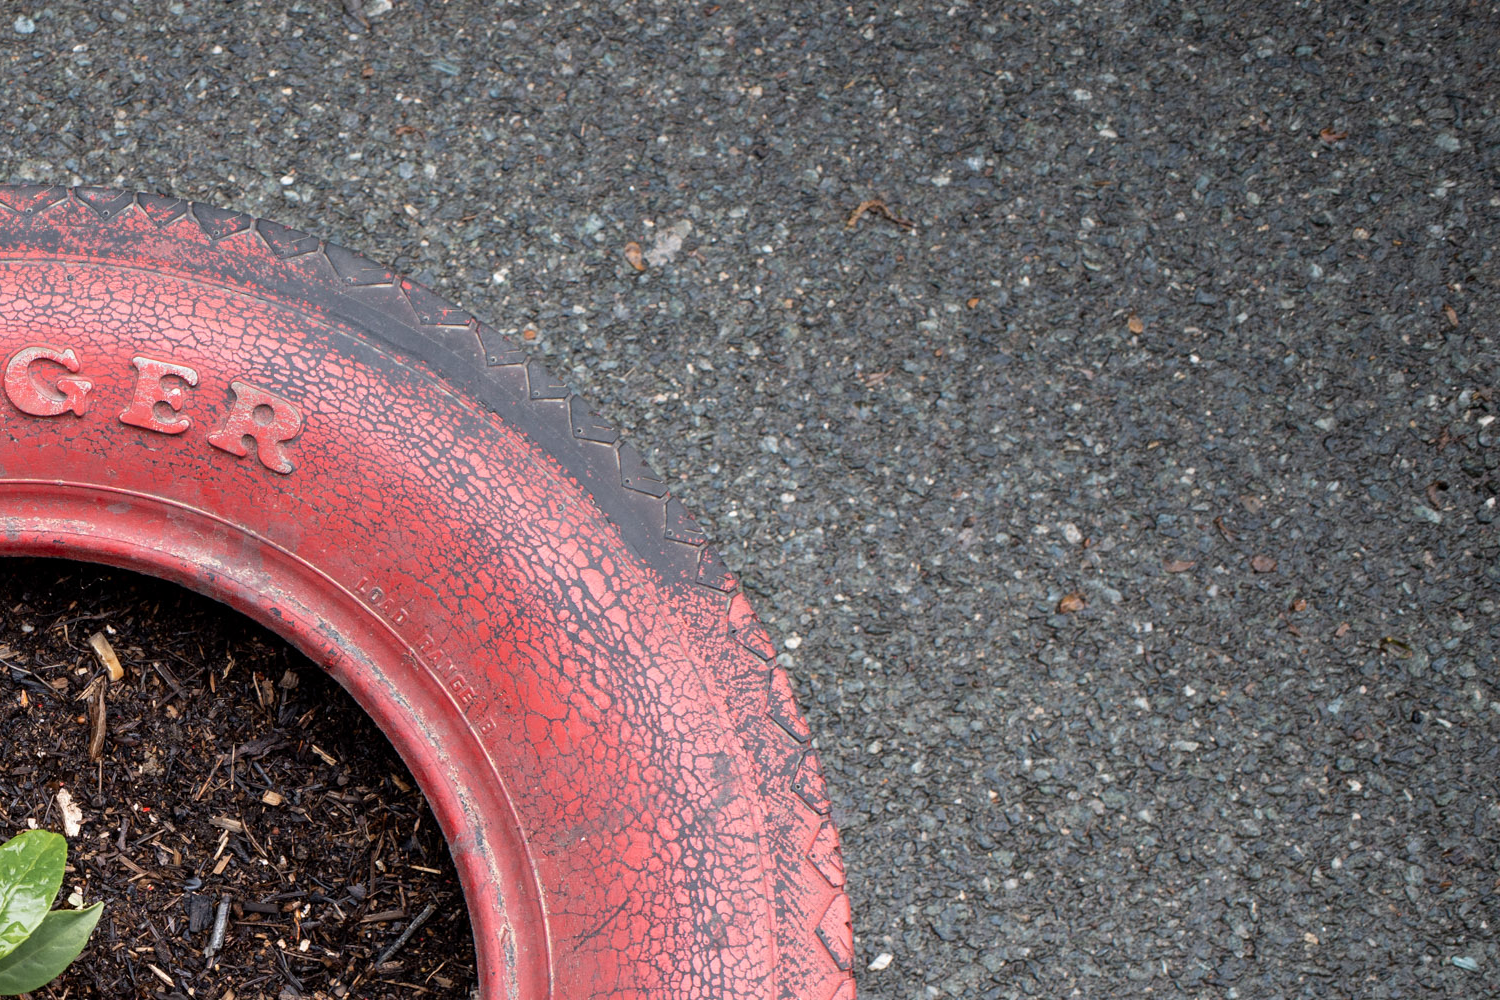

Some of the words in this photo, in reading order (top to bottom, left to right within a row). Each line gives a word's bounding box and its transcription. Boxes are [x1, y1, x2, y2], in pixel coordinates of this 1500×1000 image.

[355, 576, 410, 627] LOAD
[415, 633, 477, 704] RANGE
[478, 717, 496, 735] B
